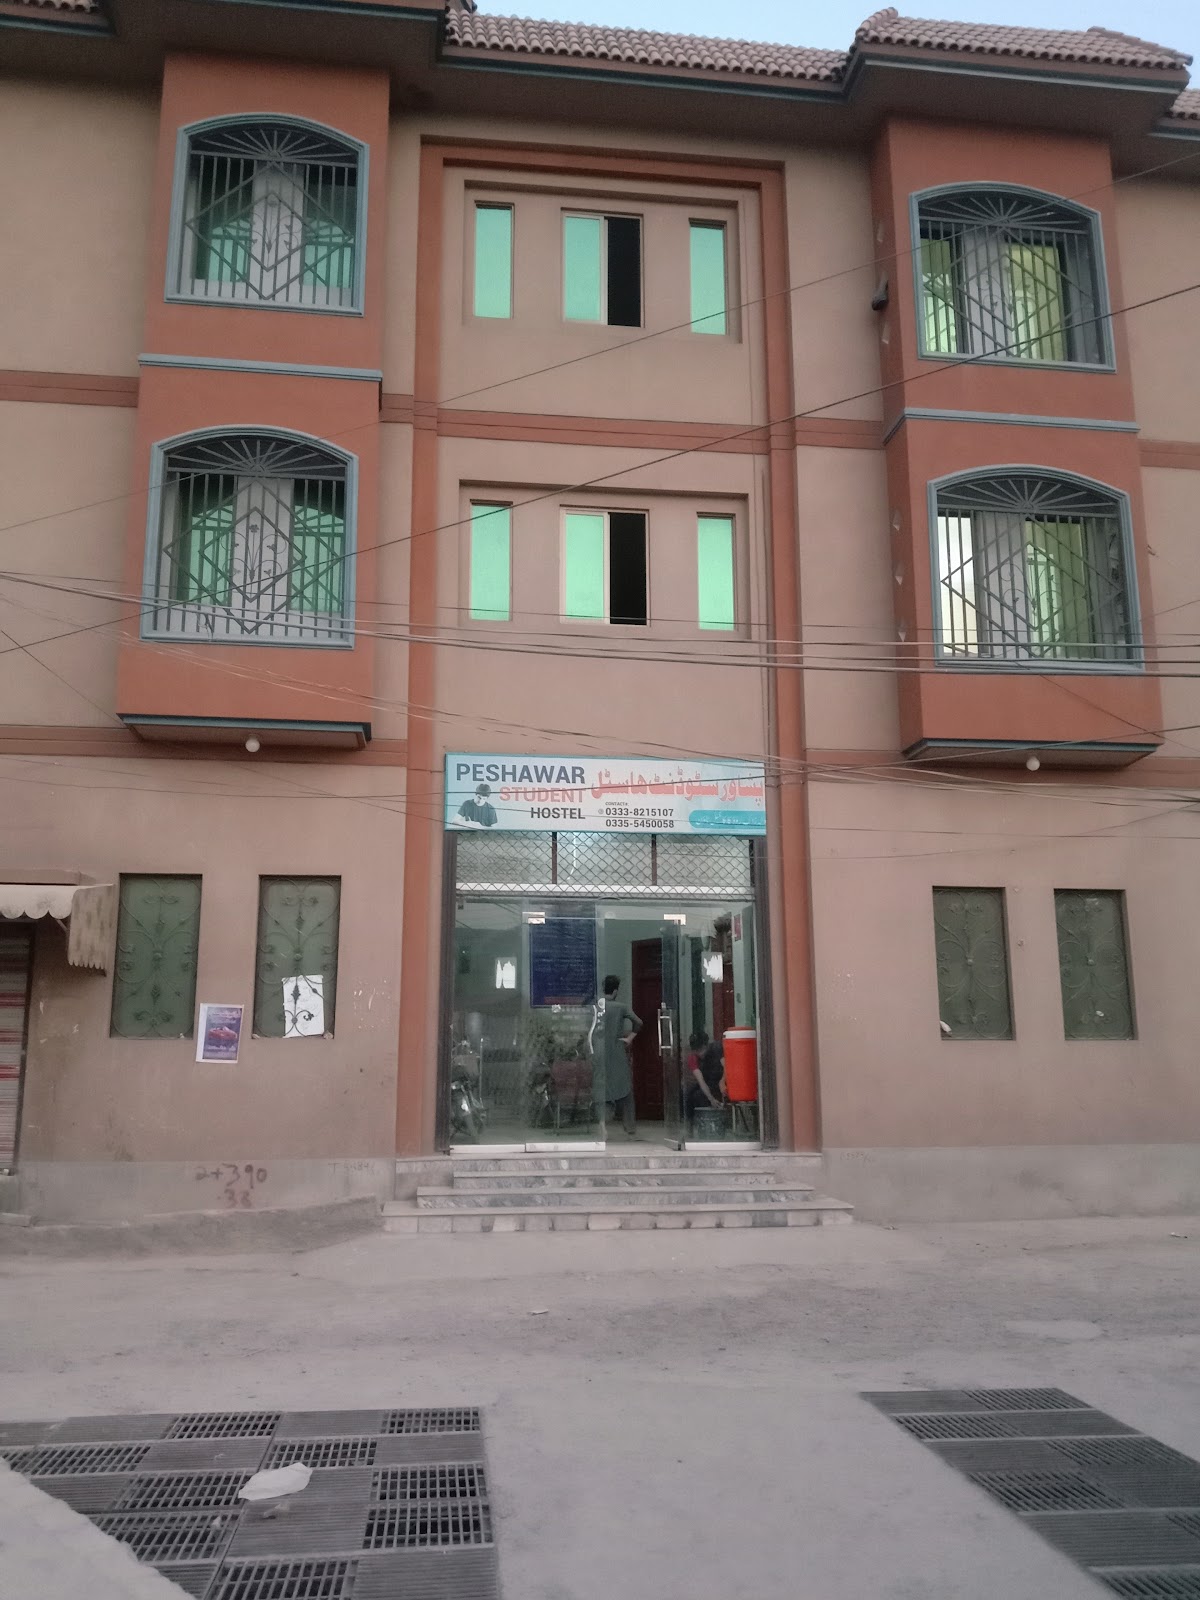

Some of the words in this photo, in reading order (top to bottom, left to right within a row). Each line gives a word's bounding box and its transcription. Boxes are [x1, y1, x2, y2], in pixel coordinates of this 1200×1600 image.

[456, 763, 586, 784] PESHAWAR
[499, 786, 586, 803] STUDENT
[719, 773, 765, 807] پشاور
[530, 807, 586, 819] HOSTEL
[605, 807, 674, 817] 0333-8215107
[605, 819, 675, 828] 0335-5450058
